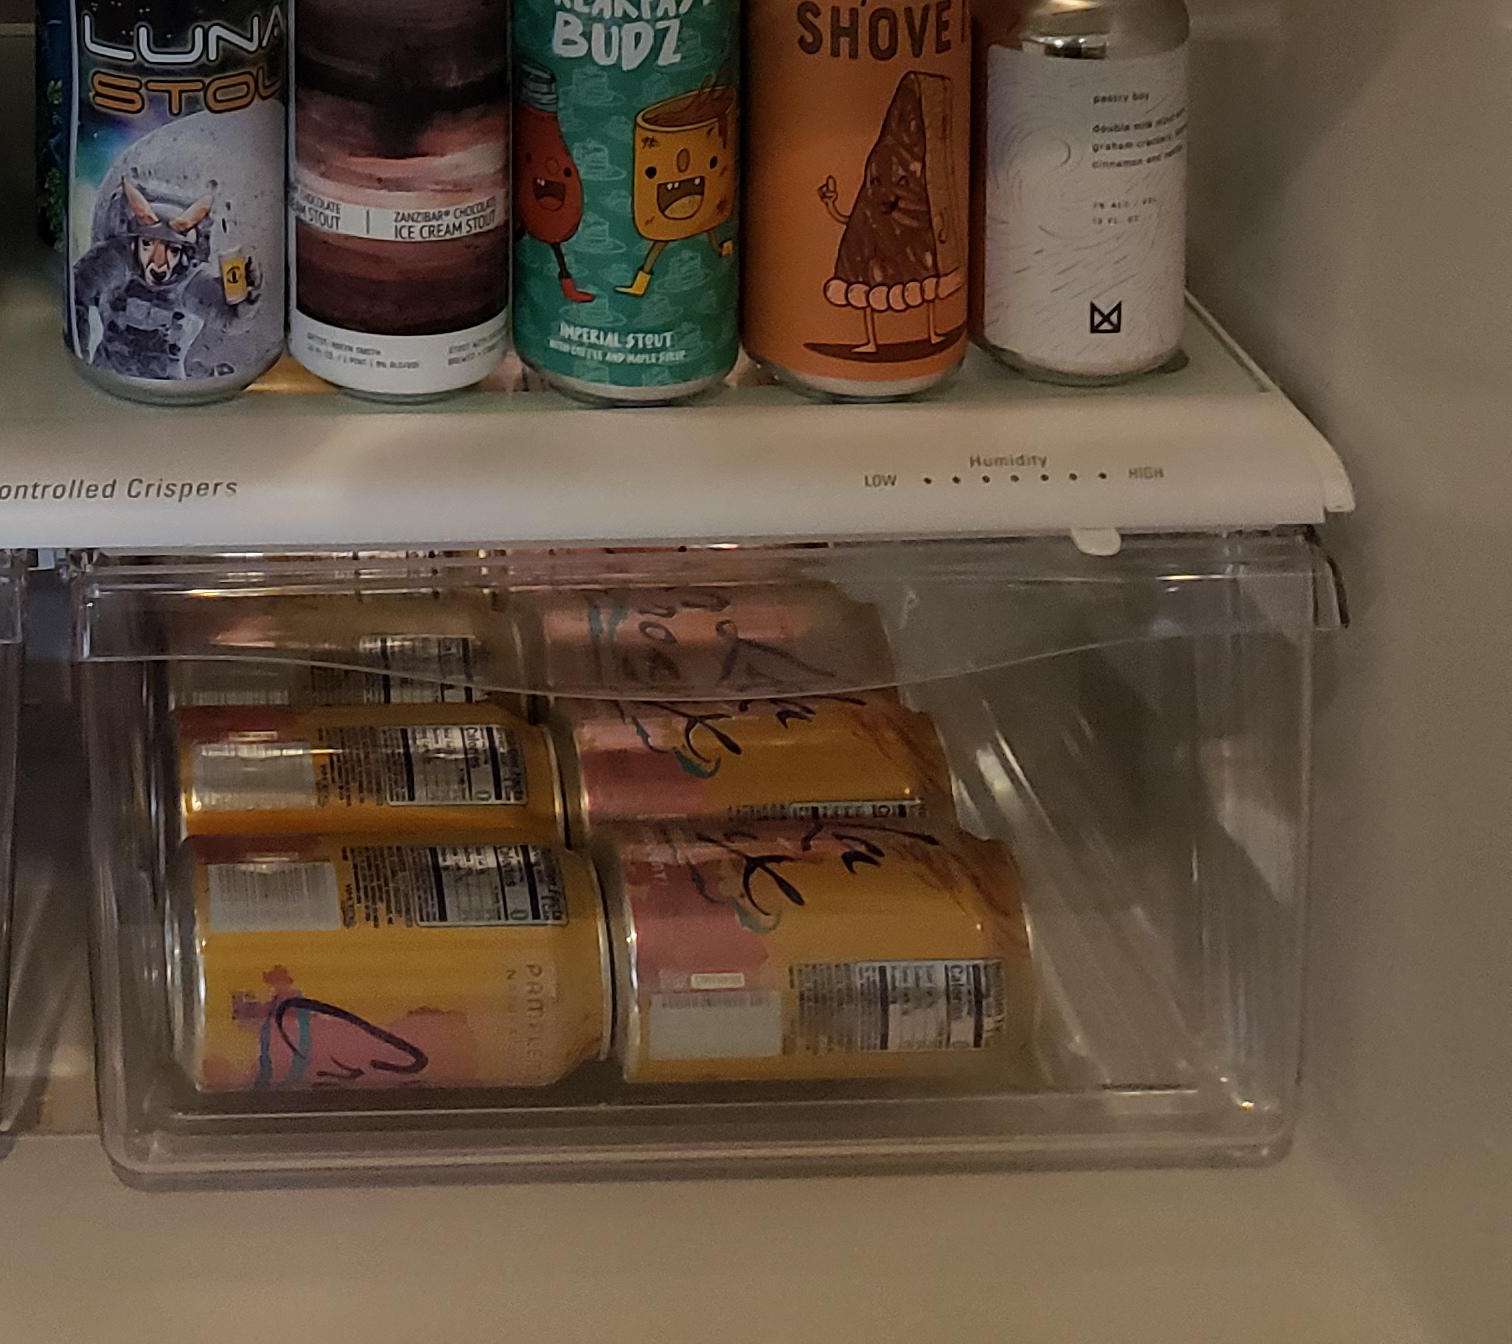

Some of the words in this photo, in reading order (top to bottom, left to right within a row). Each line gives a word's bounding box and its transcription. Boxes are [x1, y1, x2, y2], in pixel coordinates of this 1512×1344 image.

[552, 11, 684, 72] BUDZ
[796, 0, 953, 64] SHOVE
[394, 224, 416, 240] ICE
[419, 220, 463, 239] CREAM
[465, 208, 497, 234] STOUT
[559, 319, 622, 348] IMPERIAL
[626, 331, 674, 349] STOUT
[968, 454, 1048, 469] Humidity
[1128, 466, 1165, 480] HIGH
[126, 477, 239, 503] Crispers
[863, 474, 898, 488] LOW
